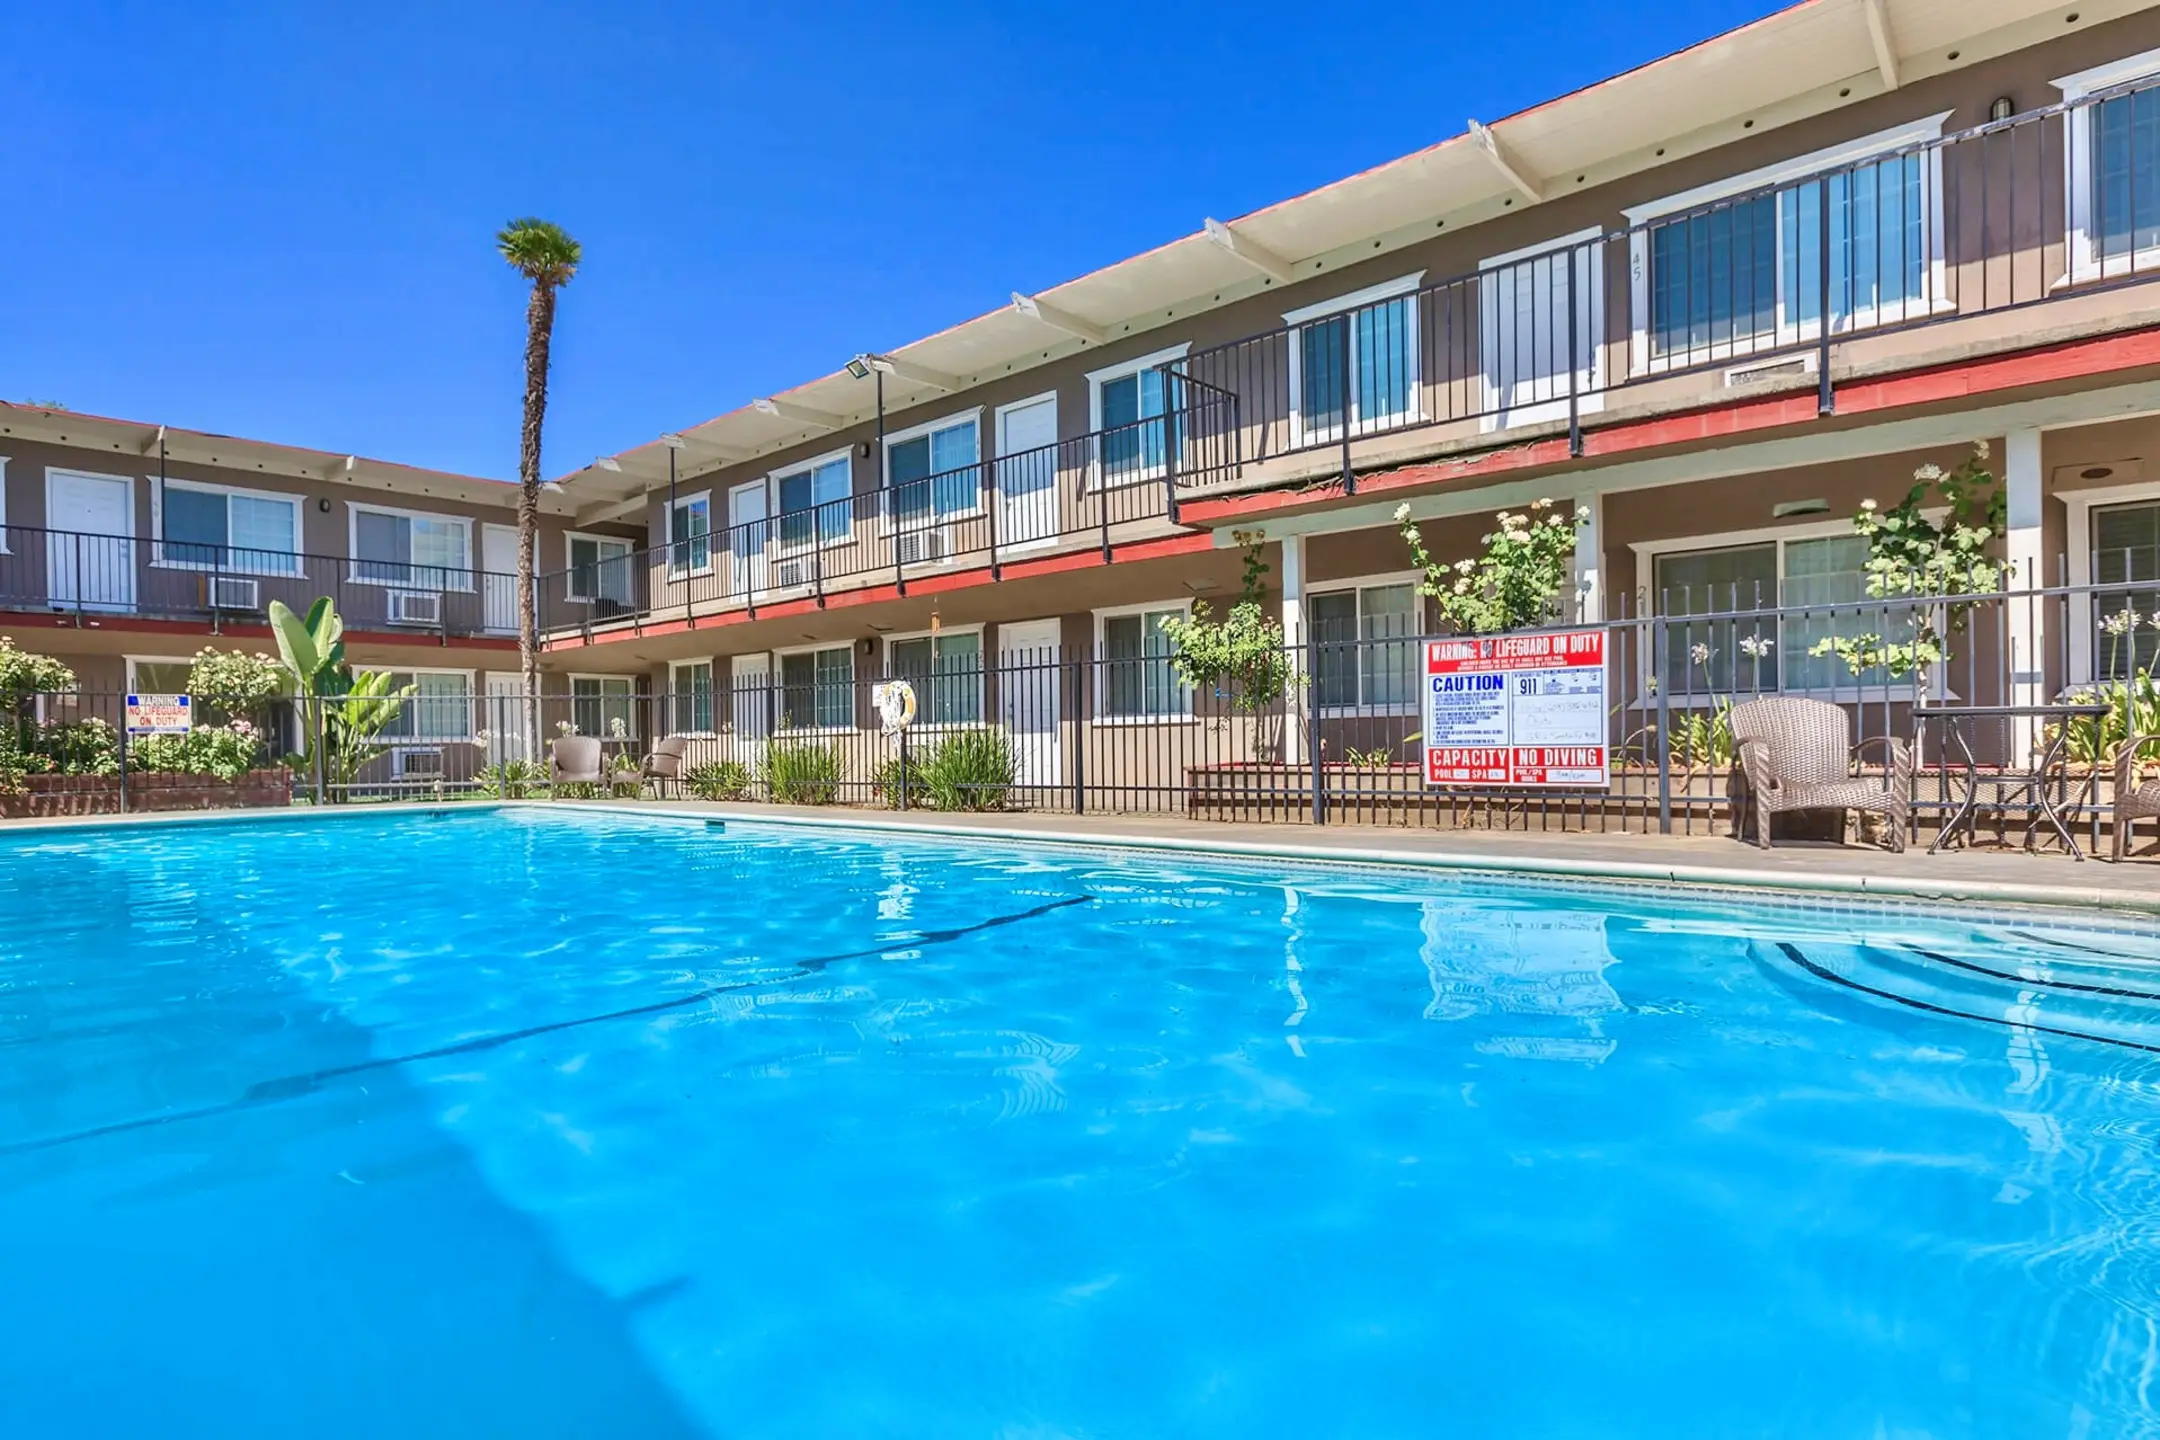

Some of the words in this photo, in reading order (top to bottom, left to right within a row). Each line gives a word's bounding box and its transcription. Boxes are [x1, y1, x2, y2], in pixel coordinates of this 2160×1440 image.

[1632, 251, 1641, 282] 45
[1496, 636, 1549, 658] LIFEGUARD
[1553, 635, 1567, 654] ON
[1570, 633, 1599, 653] DUTY
[1433, 674, 1503, 692] CAUTION
[1520, 678, 1537, 694] 911
[139, 695, 180, 706] WARNING
[128, 706, 141, 716] NO
[145, 706, 188, 716] LIFEGUARD
[140, 716, 152, 726] ON
[155, 716, 178, 725] DUTY
[1433, 749, 1507, 767] CAPACITY
[1518, 748, 1539, 766] NO
[1544, 748, 1597, 766] DIVING
[1434, 768, 1452, 779] POOL
[1471, 768, 1487, 779] SPA
